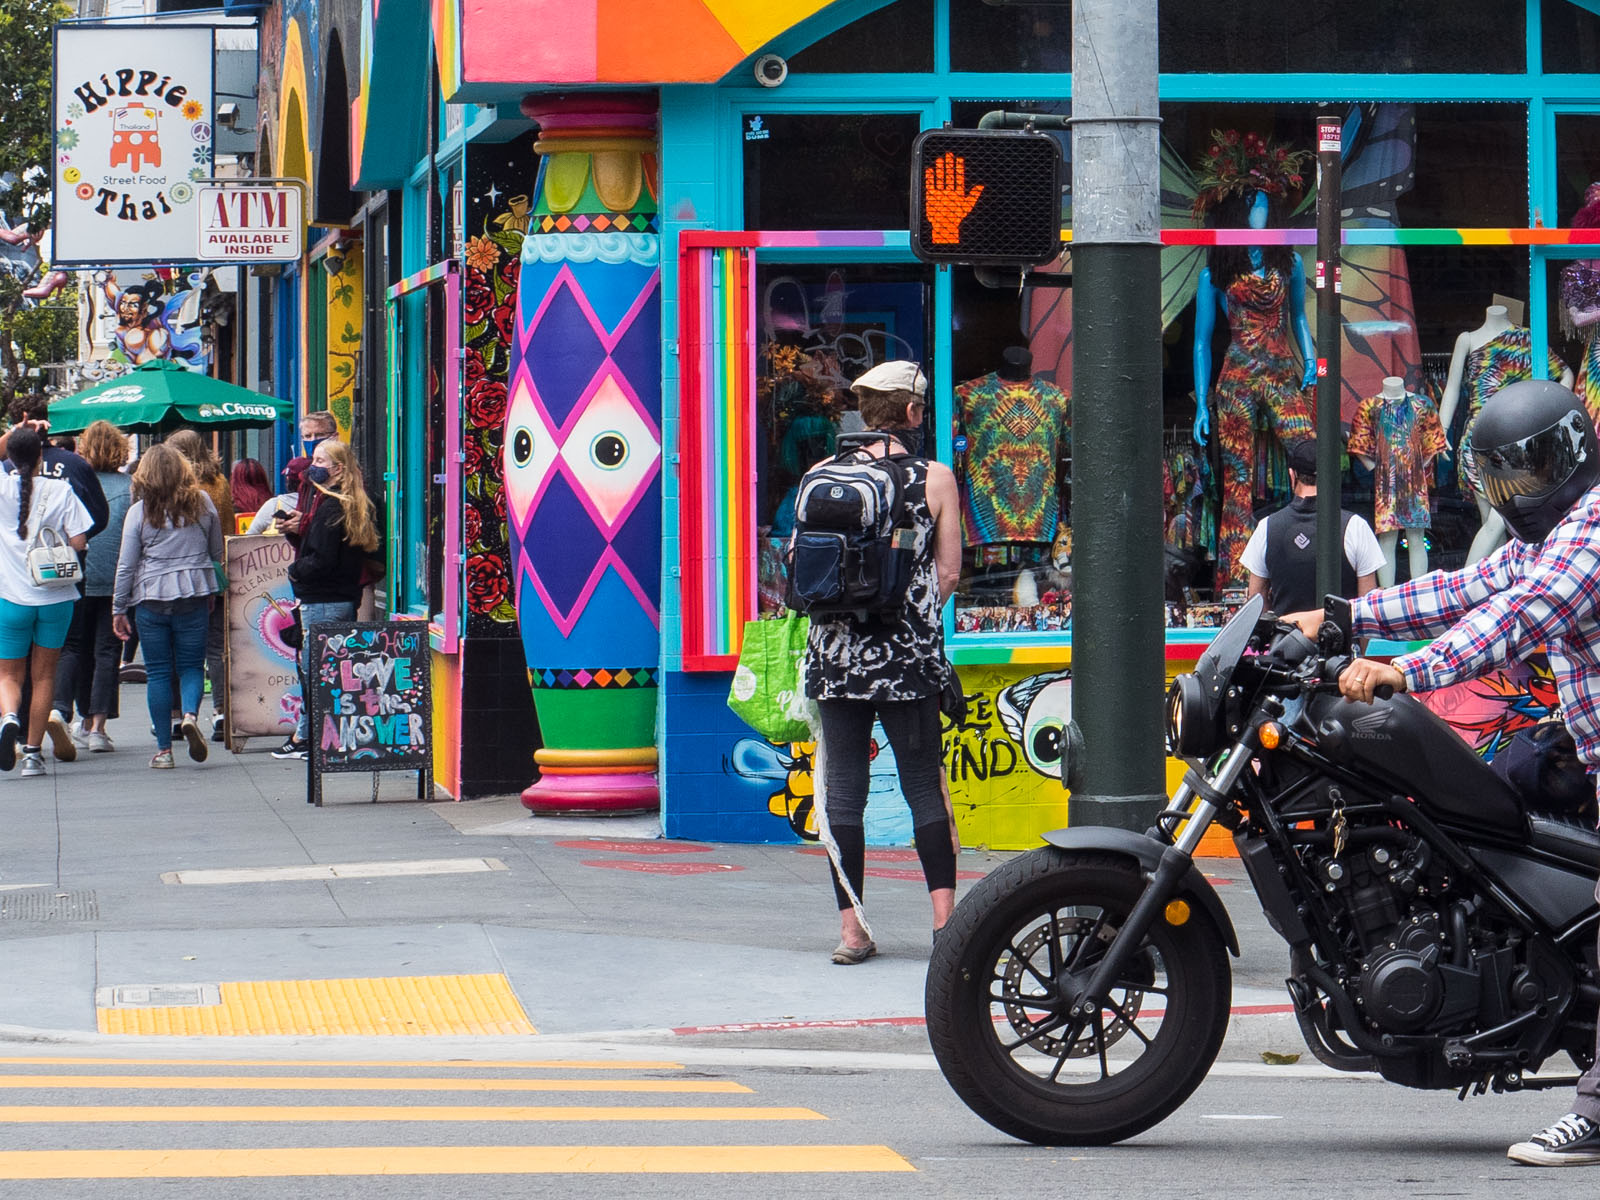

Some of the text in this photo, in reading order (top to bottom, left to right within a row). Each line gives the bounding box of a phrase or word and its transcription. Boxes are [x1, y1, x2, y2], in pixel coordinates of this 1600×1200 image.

[103, 175, 167, 185] Street Food
[95, 187, 172, 221] Thai
[208, 192, 288, 228] ATM
[209, 234, 289, 244] AVAILABLE
[224, 245, 274, 255] INSIDE
[222, 402, 277, 418] Chang
[238, 571, 273, 596] CLEAN
[320, 713, 425, 752] ANSWER
[1351, 731, 1392, 740] HONDA
